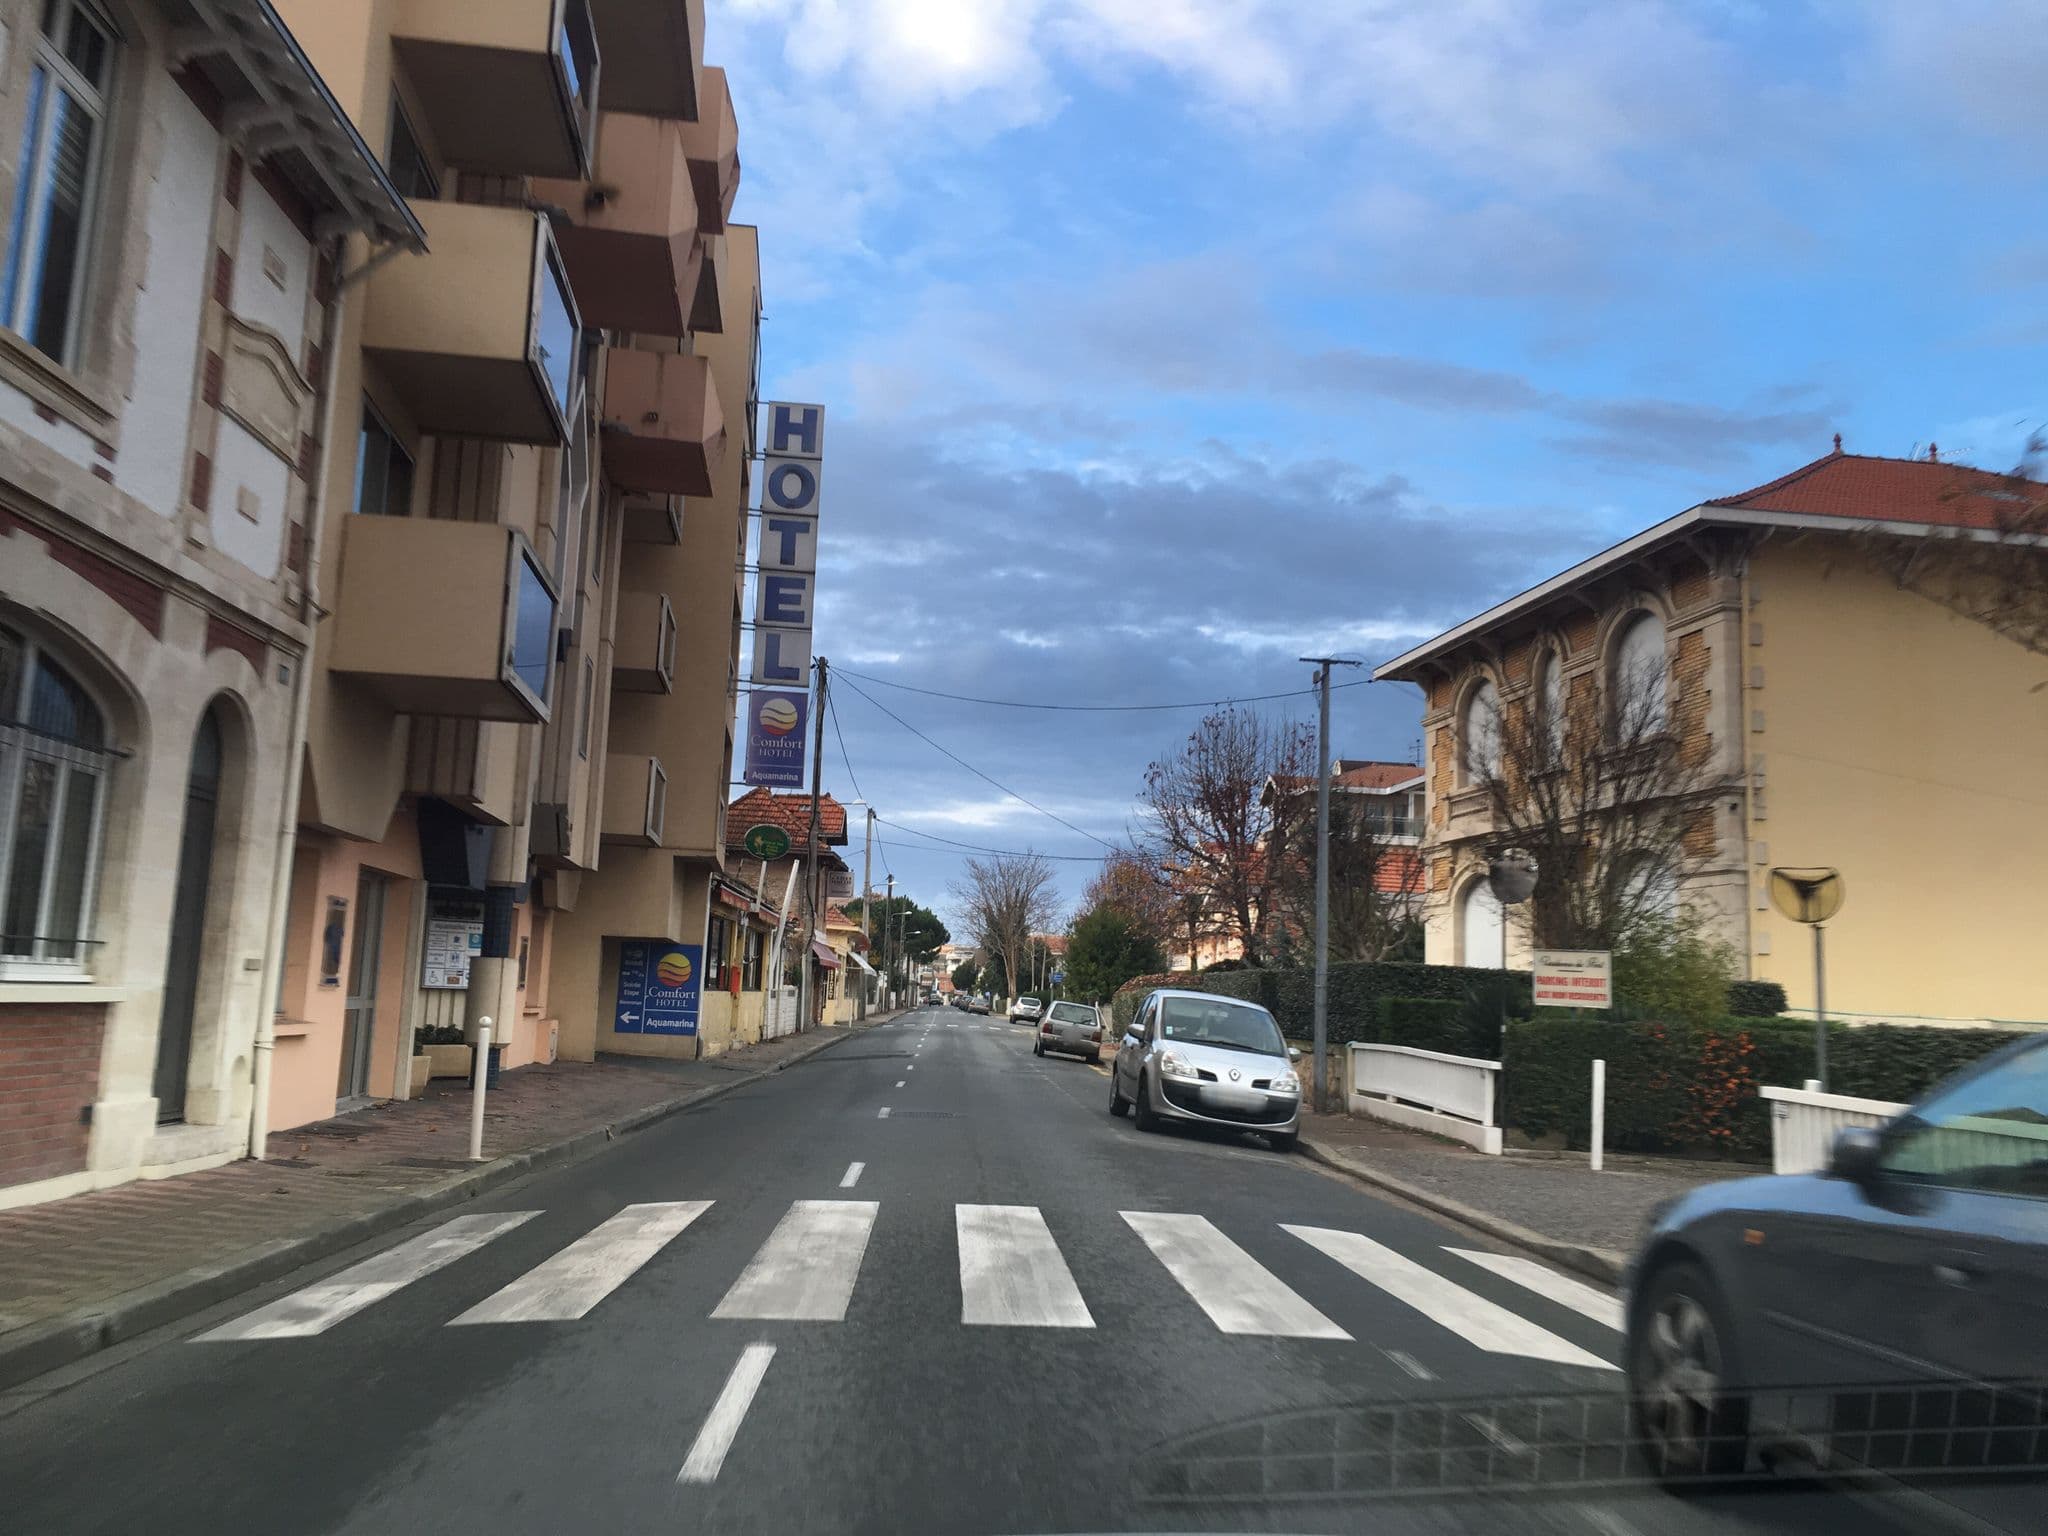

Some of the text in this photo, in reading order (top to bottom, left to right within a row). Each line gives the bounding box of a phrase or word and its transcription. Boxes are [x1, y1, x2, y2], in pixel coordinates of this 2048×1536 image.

[763, 406, 818, 681] HOTEL
[751, 735, 802, 748] Comfort
[759, 748, 793, 757] HOTEL
[752, 771, 799, 780] Aquamarina
[1536, 976, 1606, 988] PARKING INTERDIT
[648, 986, 696, 999] Comfort
[656, 998, 688, 1007] HOTEL
[646, 1018, 694, 1028] Aquamarina
